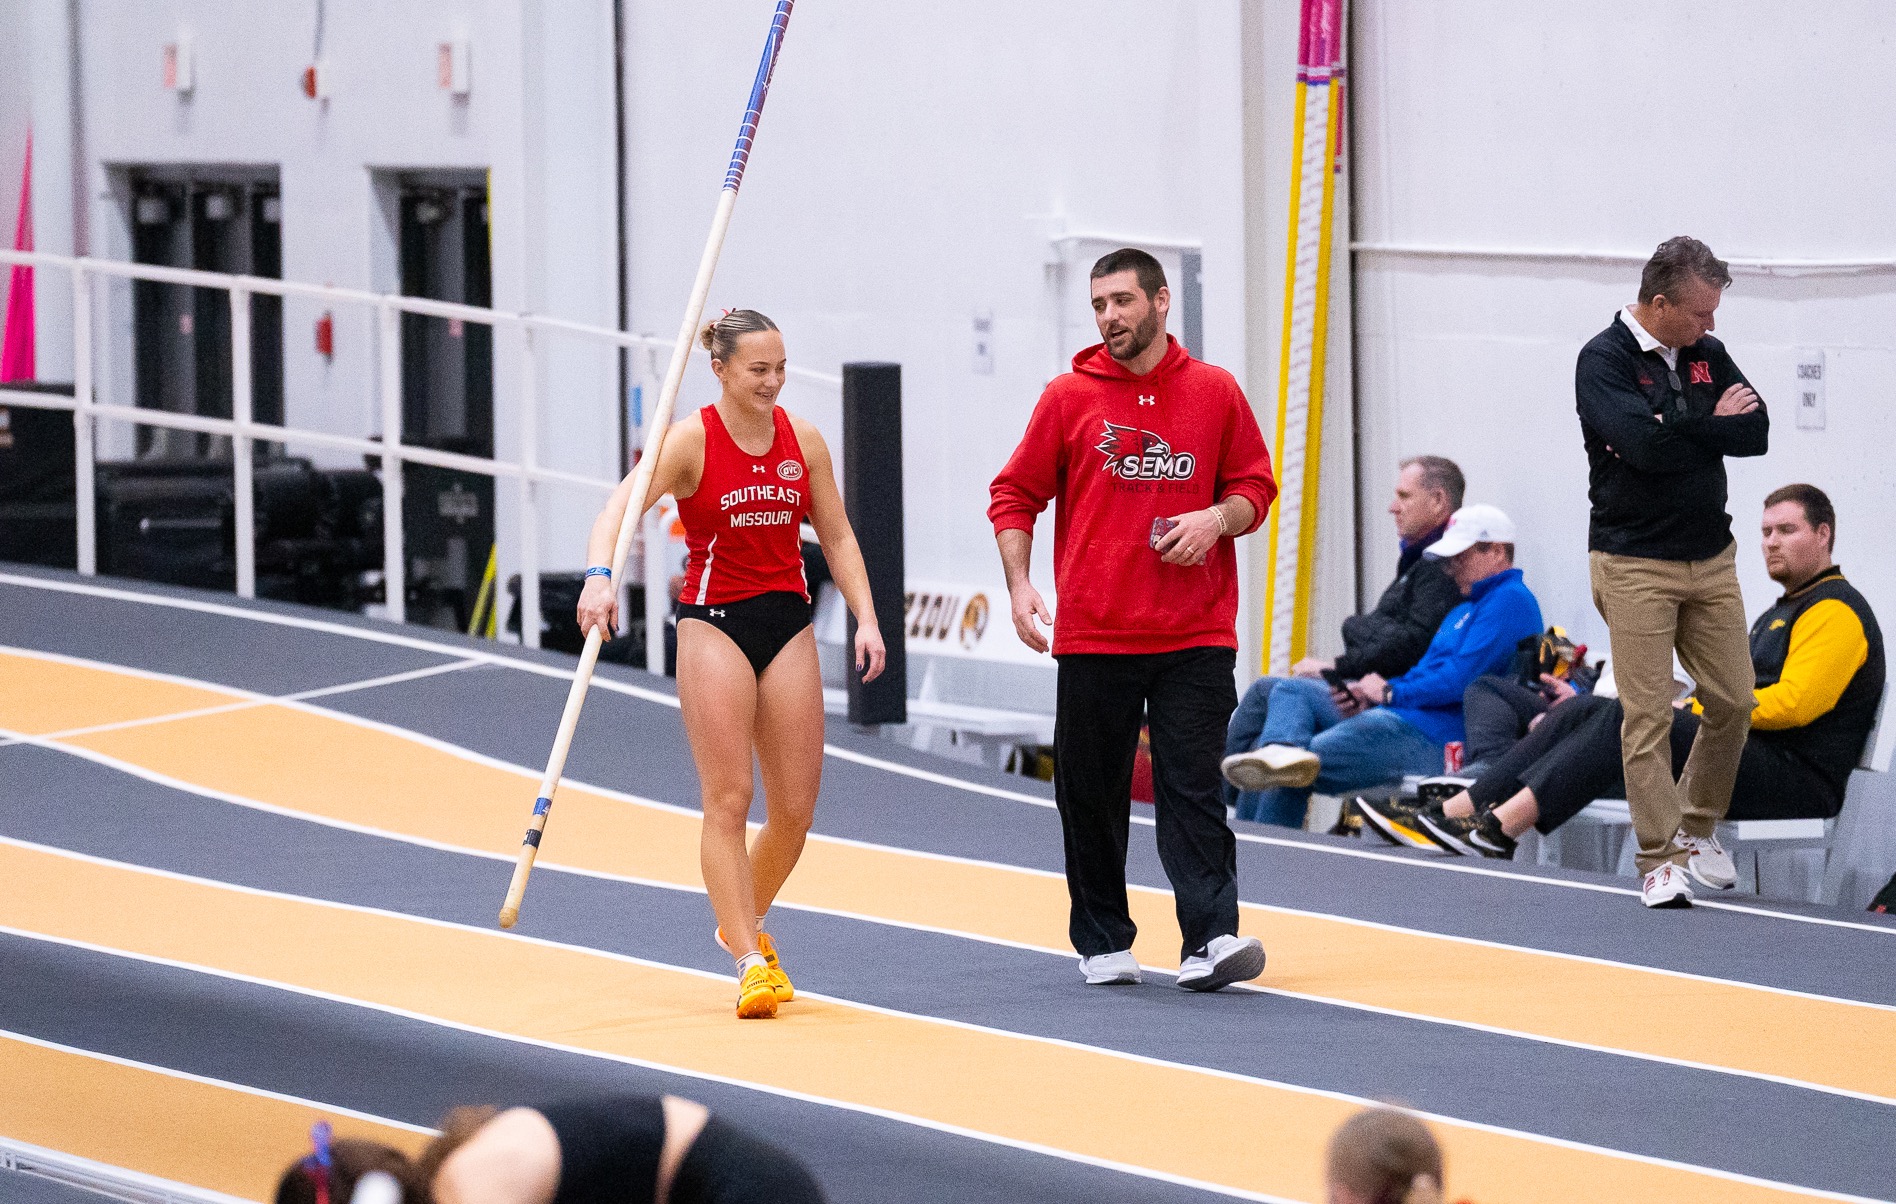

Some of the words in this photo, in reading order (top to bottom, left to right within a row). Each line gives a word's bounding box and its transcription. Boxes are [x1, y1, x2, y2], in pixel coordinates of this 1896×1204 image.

[1689, 361, 1713, 384] N
[1797, 364, 1821, 379] COACHES
[1803, 392, 1816, 407] ONLY
[783, 466, 799, 476] OVC
[1120, 454, 1194, 479] SEMO
[1112, 482, 1152, 493] TRACK
[1168, 483, 1200, 494] FIELD
[720, 485, 801, 511] SOUTHEAST
[730, 511, 793, 528] MISSOURI
